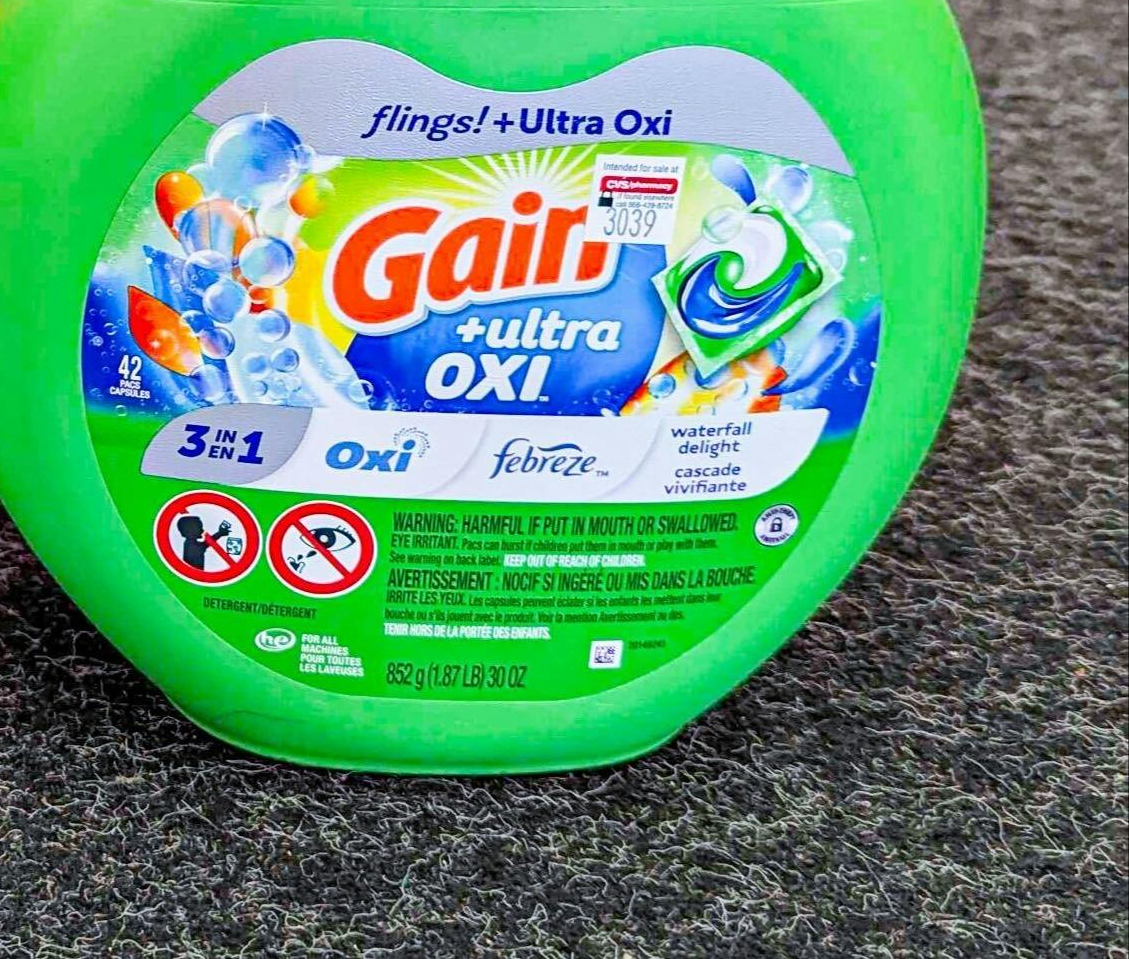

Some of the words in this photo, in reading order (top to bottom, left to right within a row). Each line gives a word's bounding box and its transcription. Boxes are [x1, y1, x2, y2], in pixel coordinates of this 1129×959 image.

[360, 104, 490, 142] flings!
[613, 108, 674, 137] Oxi
[603, 162, 638, 172] Intended
[639, 163, 652, 173] for
[653, 164, 669, 174] sale
[671, 165, 679, 174] at
[603, 207, 657, 238] 3039
[117, 354, 143, 381] 42
[109, 386, 151, 400] CAPSULES
[120, 380, 142, 390] PACS
[670, 421, 753, 439] waterfall
[177, 423, 211, 458] 3
[214, 429, 238, 444] IN
[237, 430, 264, 465] 1
[207, 444, 235, 460] EN
[678, 438, 741, 456] delight
[324, 437, 418, 473] Oxi
[674, 463, 742, 479] cascade
[663, 479, 747, 496] vivifiante
[393, 511, 458, 534] WARNING:
[461, 514, 523, 536] HARMFUL
[527, 515, 541, 536] IF
[543, 515, 569, 537] PUT
[572, 515, 586, 536] IN
[588, 514, 634, 536] MOUTH
[637, 514, 654, 536] OR
[657, 512, 738, 535] SWALLOWED.
[390, 533, 411, 548] EYE
[389, 550, 407, 564] See
[407, 553, 442, 567] warning
[503, 553, 527, 568] KEEP
[527, 553, 546, 568] OUT
[546, 554, 558, 568] OF
[558, 554, 588, 568] REACH
[588, 554, 601, 568] OF
[387, 568, 493, 591] AVERTISSEMENT
[501, 570, 539, 592] NOCIF
[541, 571, 555, 592] SI
[557, 567, 602, 593] INGÉRÉ
[605, 572, 623, 592] OU
[626, 571, 648, 592] MIS
[652, 570, 686, 591] DANS
[687, 569, 706, 590] LA
[385, 589, 419, 604] IRRITE
[419, 591, 439, 605] LES
[383, 622, 409, 637] TENIR
[409, 623, 434, 638] HORS
[434, 624, 448, 639] DE
[301, 633, 321, 644] FOR
[321, 635, 339, 646] ALL
[300, 643, 350, 657] MACHINES
[300, 653, 326, 664] POUR
[326, 655, 363, 667] TOUTES
[298, 662, 317, 674] LES
[317, 664, 365, 678] LAVEUSES
[385, 660, 413, 686] 852
[414, 668, 427, 691] g
[427, 662, 460, 690] (1.87
[462, 663, 486, 690] LB)
[487, 665, 507, 689] 30
[508, 665, 527, 690] OZ
